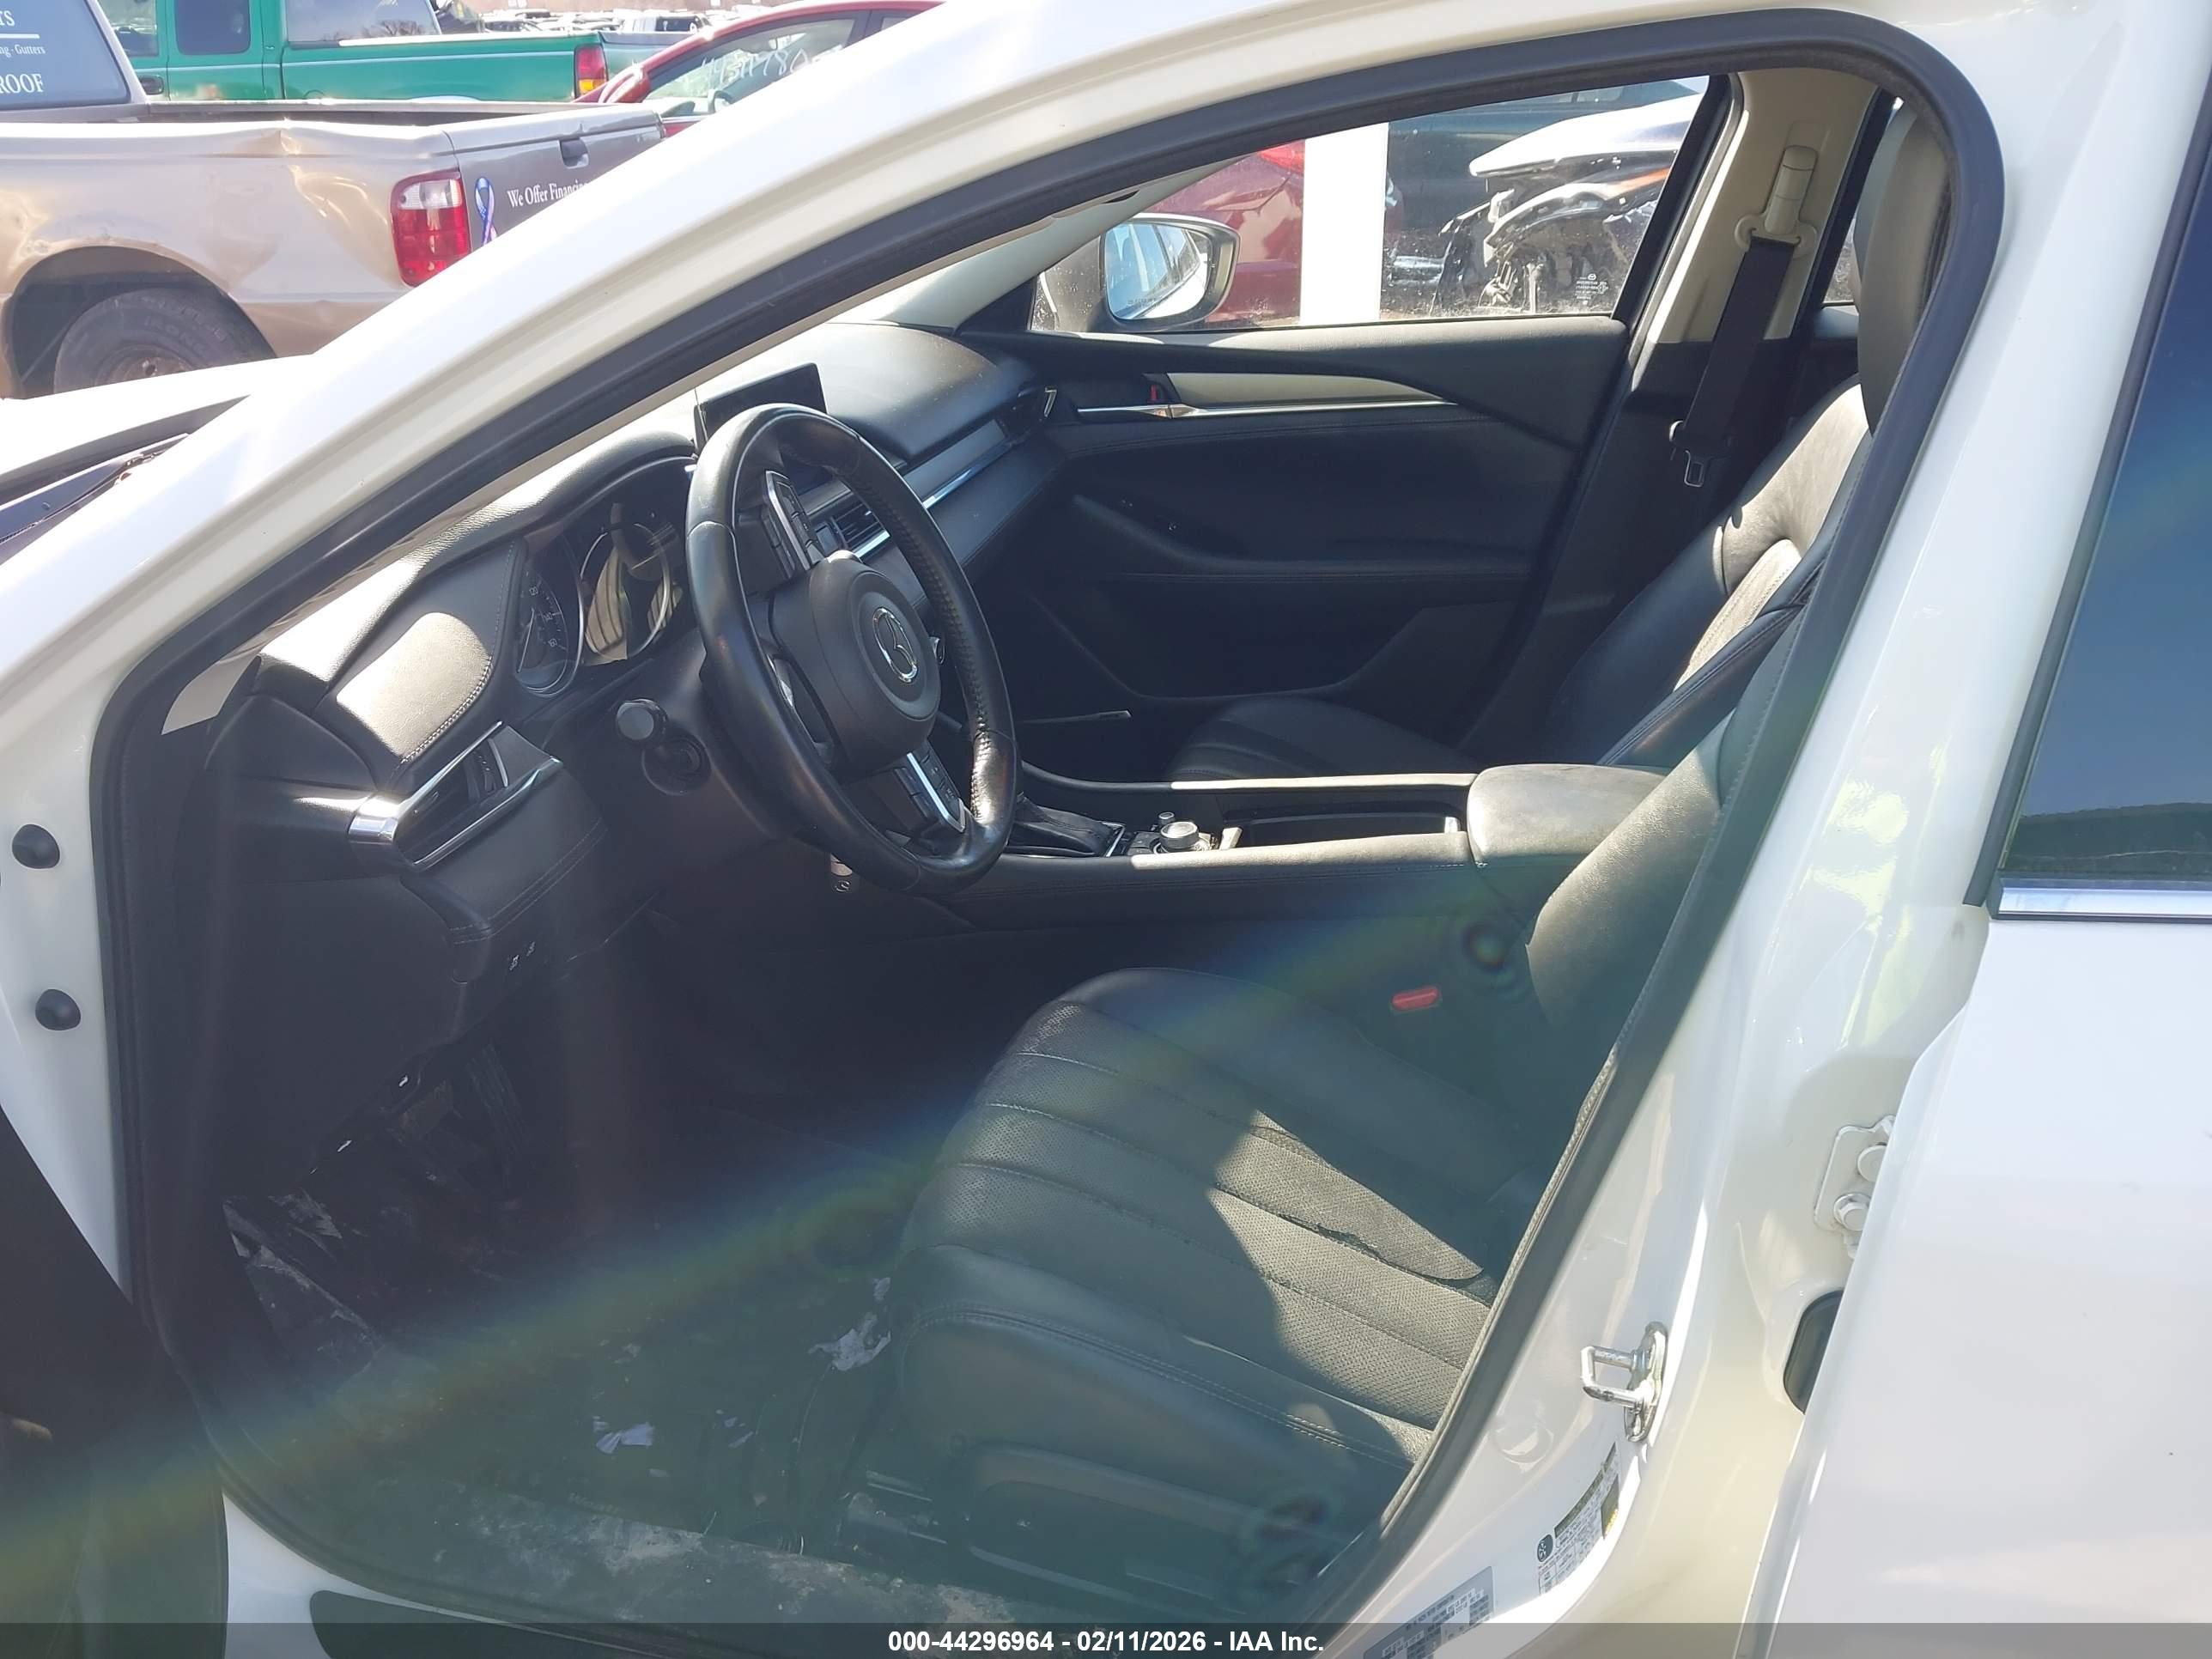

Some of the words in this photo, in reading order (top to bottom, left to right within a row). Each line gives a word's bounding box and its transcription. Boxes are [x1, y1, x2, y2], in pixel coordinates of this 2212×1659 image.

[14, 44, 46, 54] Gutters
[507, 190, 524, 208] We
[525, 184, 548, 205] Offer
